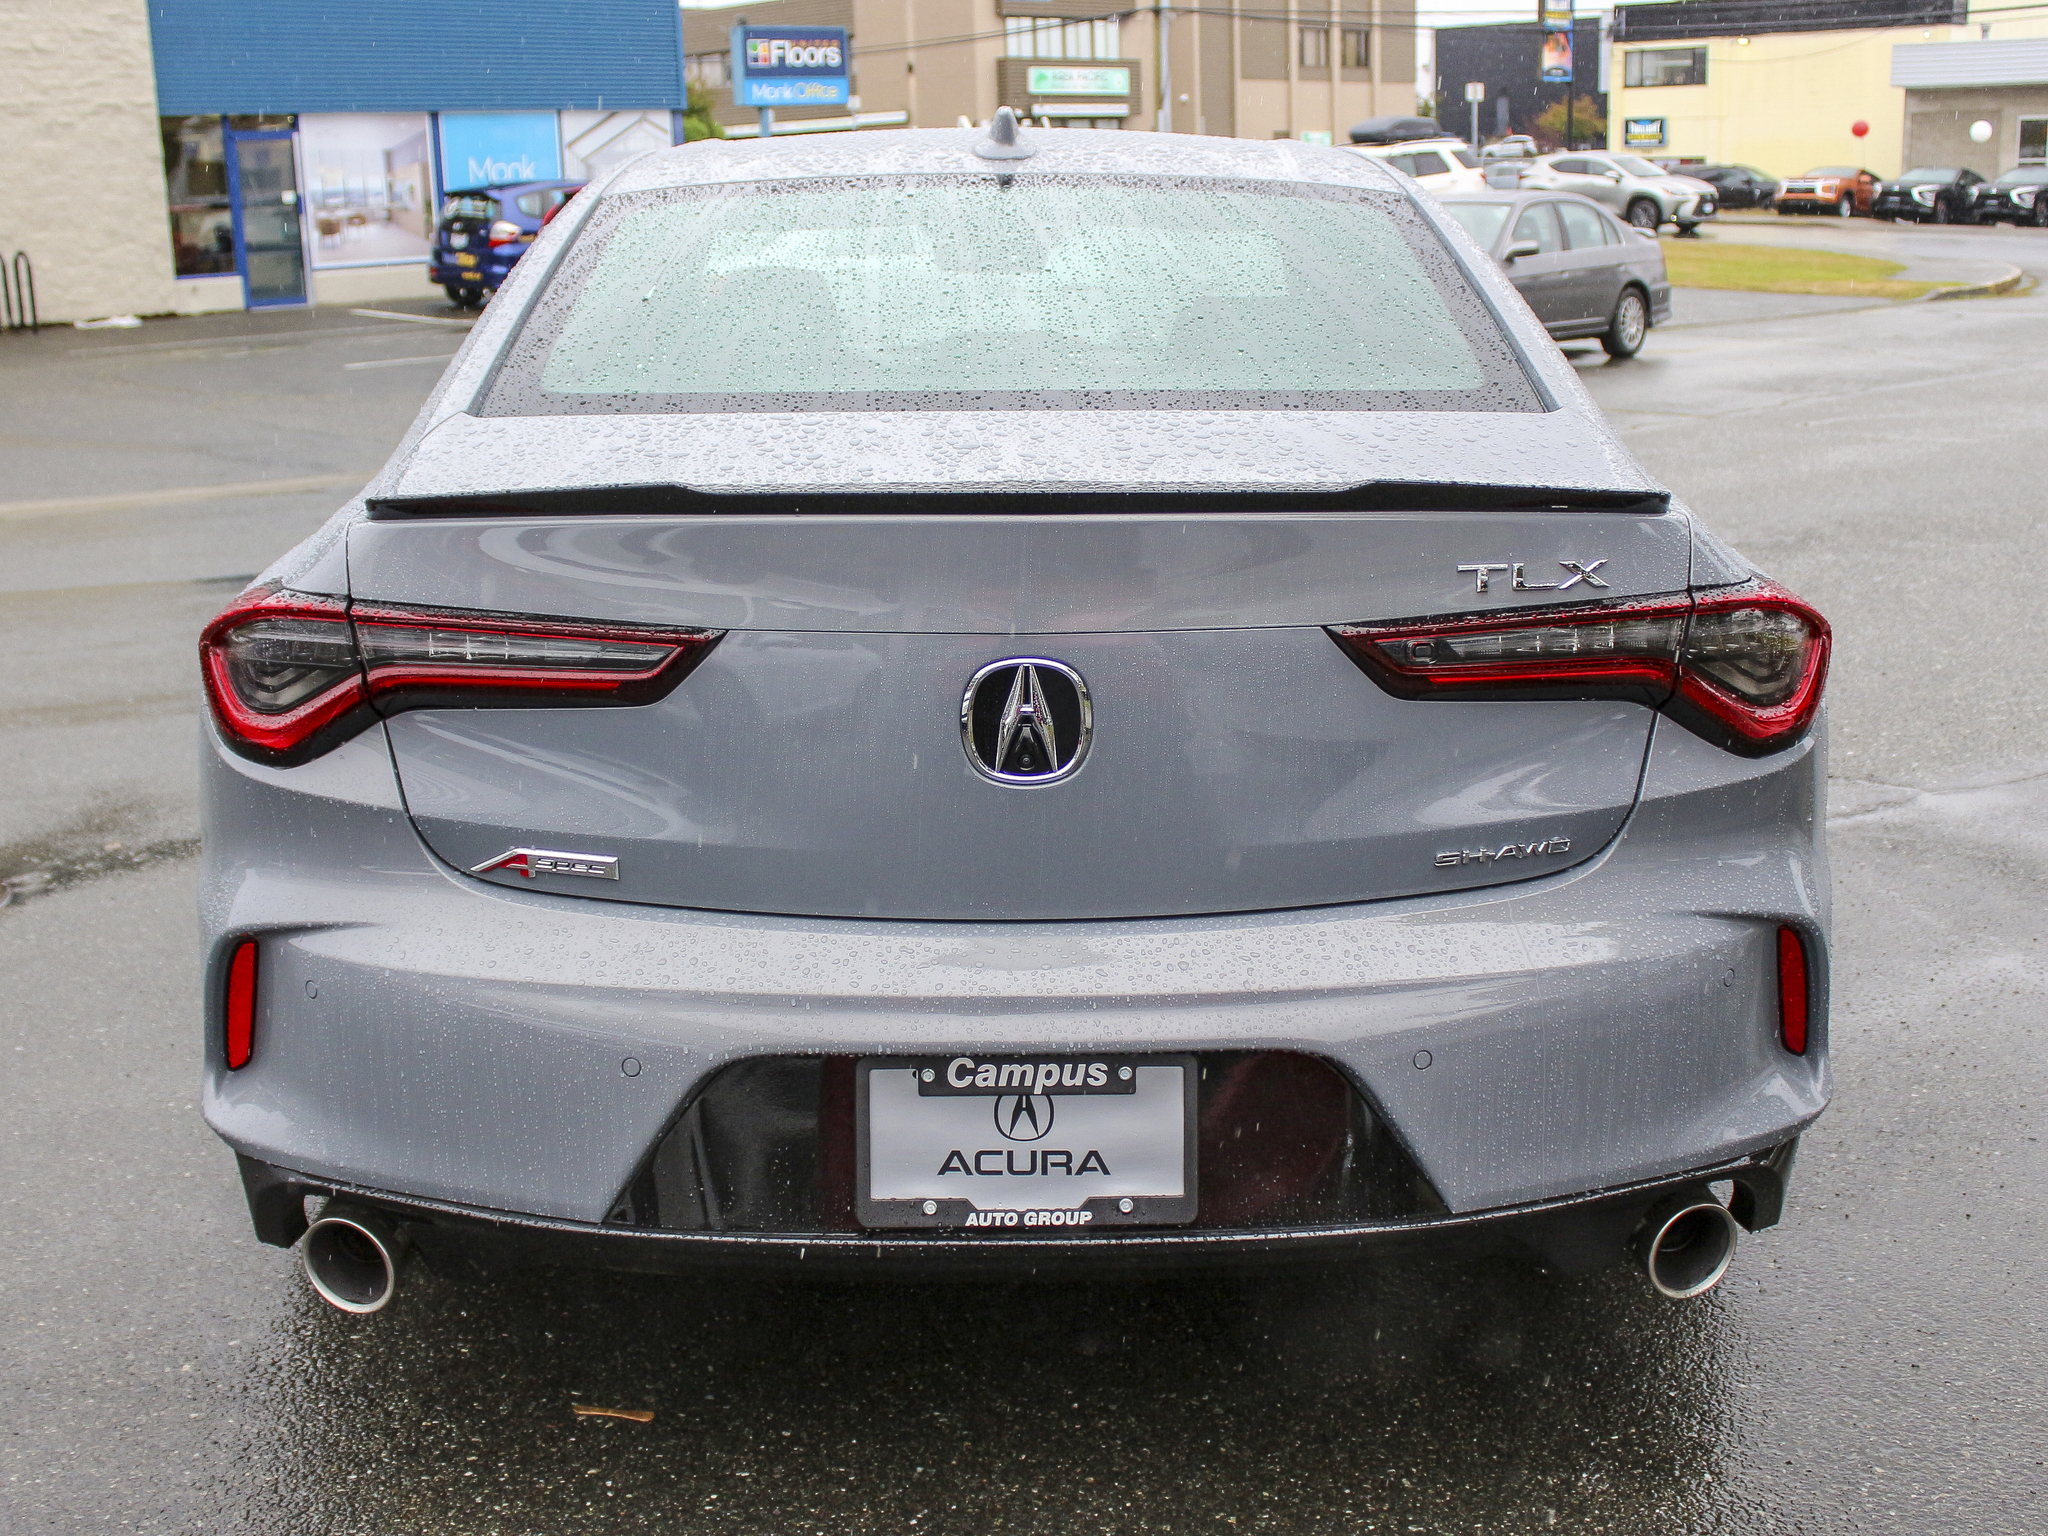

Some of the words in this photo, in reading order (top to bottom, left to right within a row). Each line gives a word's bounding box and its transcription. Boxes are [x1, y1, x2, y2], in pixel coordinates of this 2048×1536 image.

[770, 39, 842, 68] Floors
[468, 154, 535, 184] Monk
[1457, 558, 1611, 593] TLX
[947, 1057, 1108, 1094] Campus
[937, 1150, 1112, 1176] ACURA
[965, 1213, 1018, 1227] AUTO
[1024, 1211, 1093, 1226] GROUP
